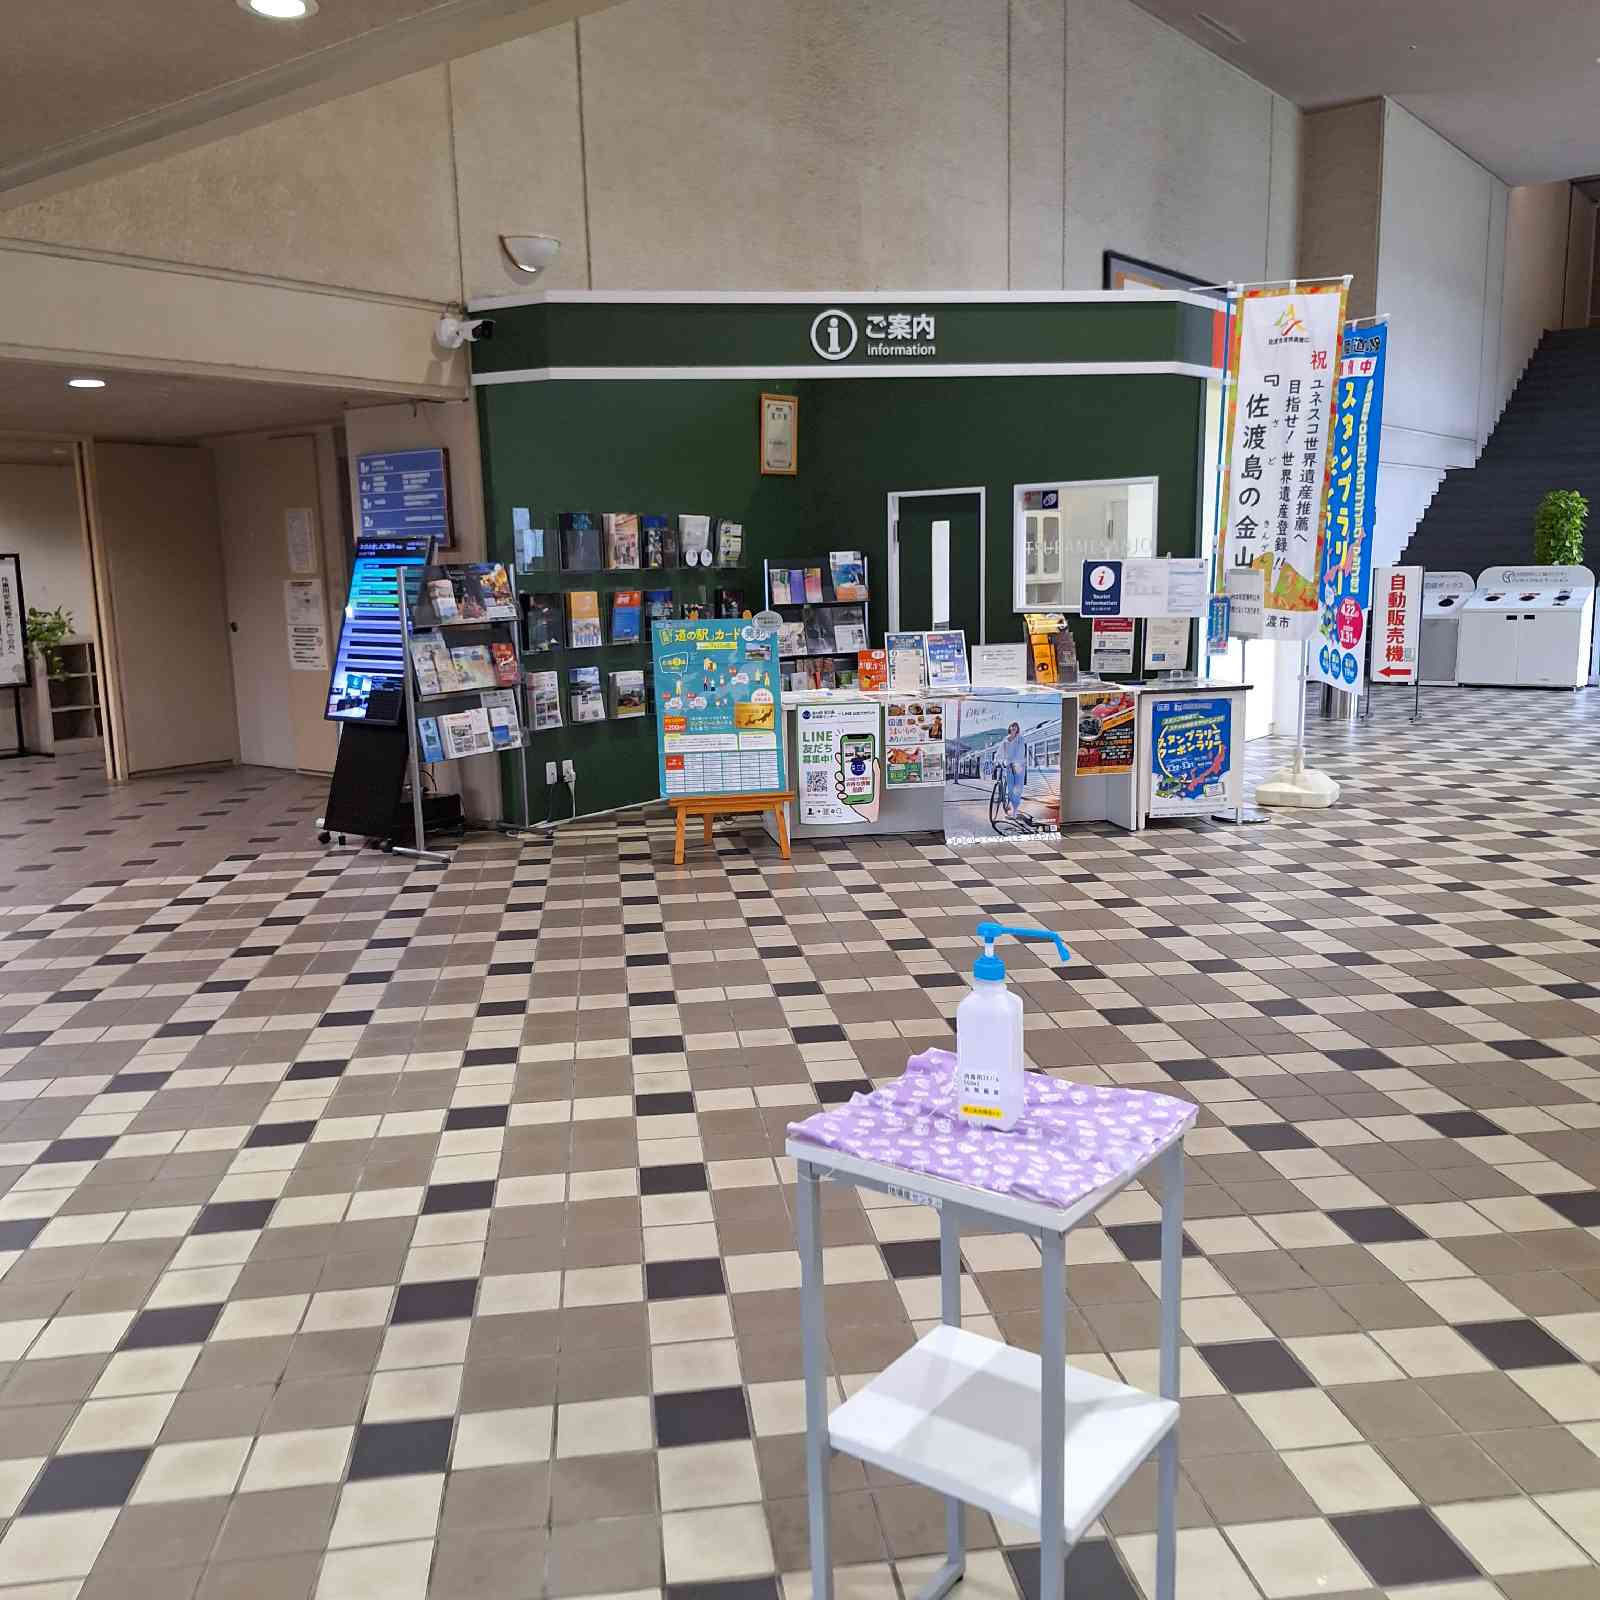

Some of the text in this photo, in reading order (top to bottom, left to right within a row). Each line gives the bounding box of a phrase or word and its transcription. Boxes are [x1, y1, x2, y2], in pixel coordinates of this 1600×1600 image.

[865, 313, 936, 340] ご案内
[867, 342, 937, 357] Information
[1311, 350, 1328, 370] 祝
[1293, 379, 1325, 544] ユネスコ世界遺産推薦へ
[1336, 381, 1357, 595] スタンプラリー
[1384, 574, 1407, 663] 自動販売機
[803, 731, 833, 743] LINE
[803, 744, 833, 754] 友だち
